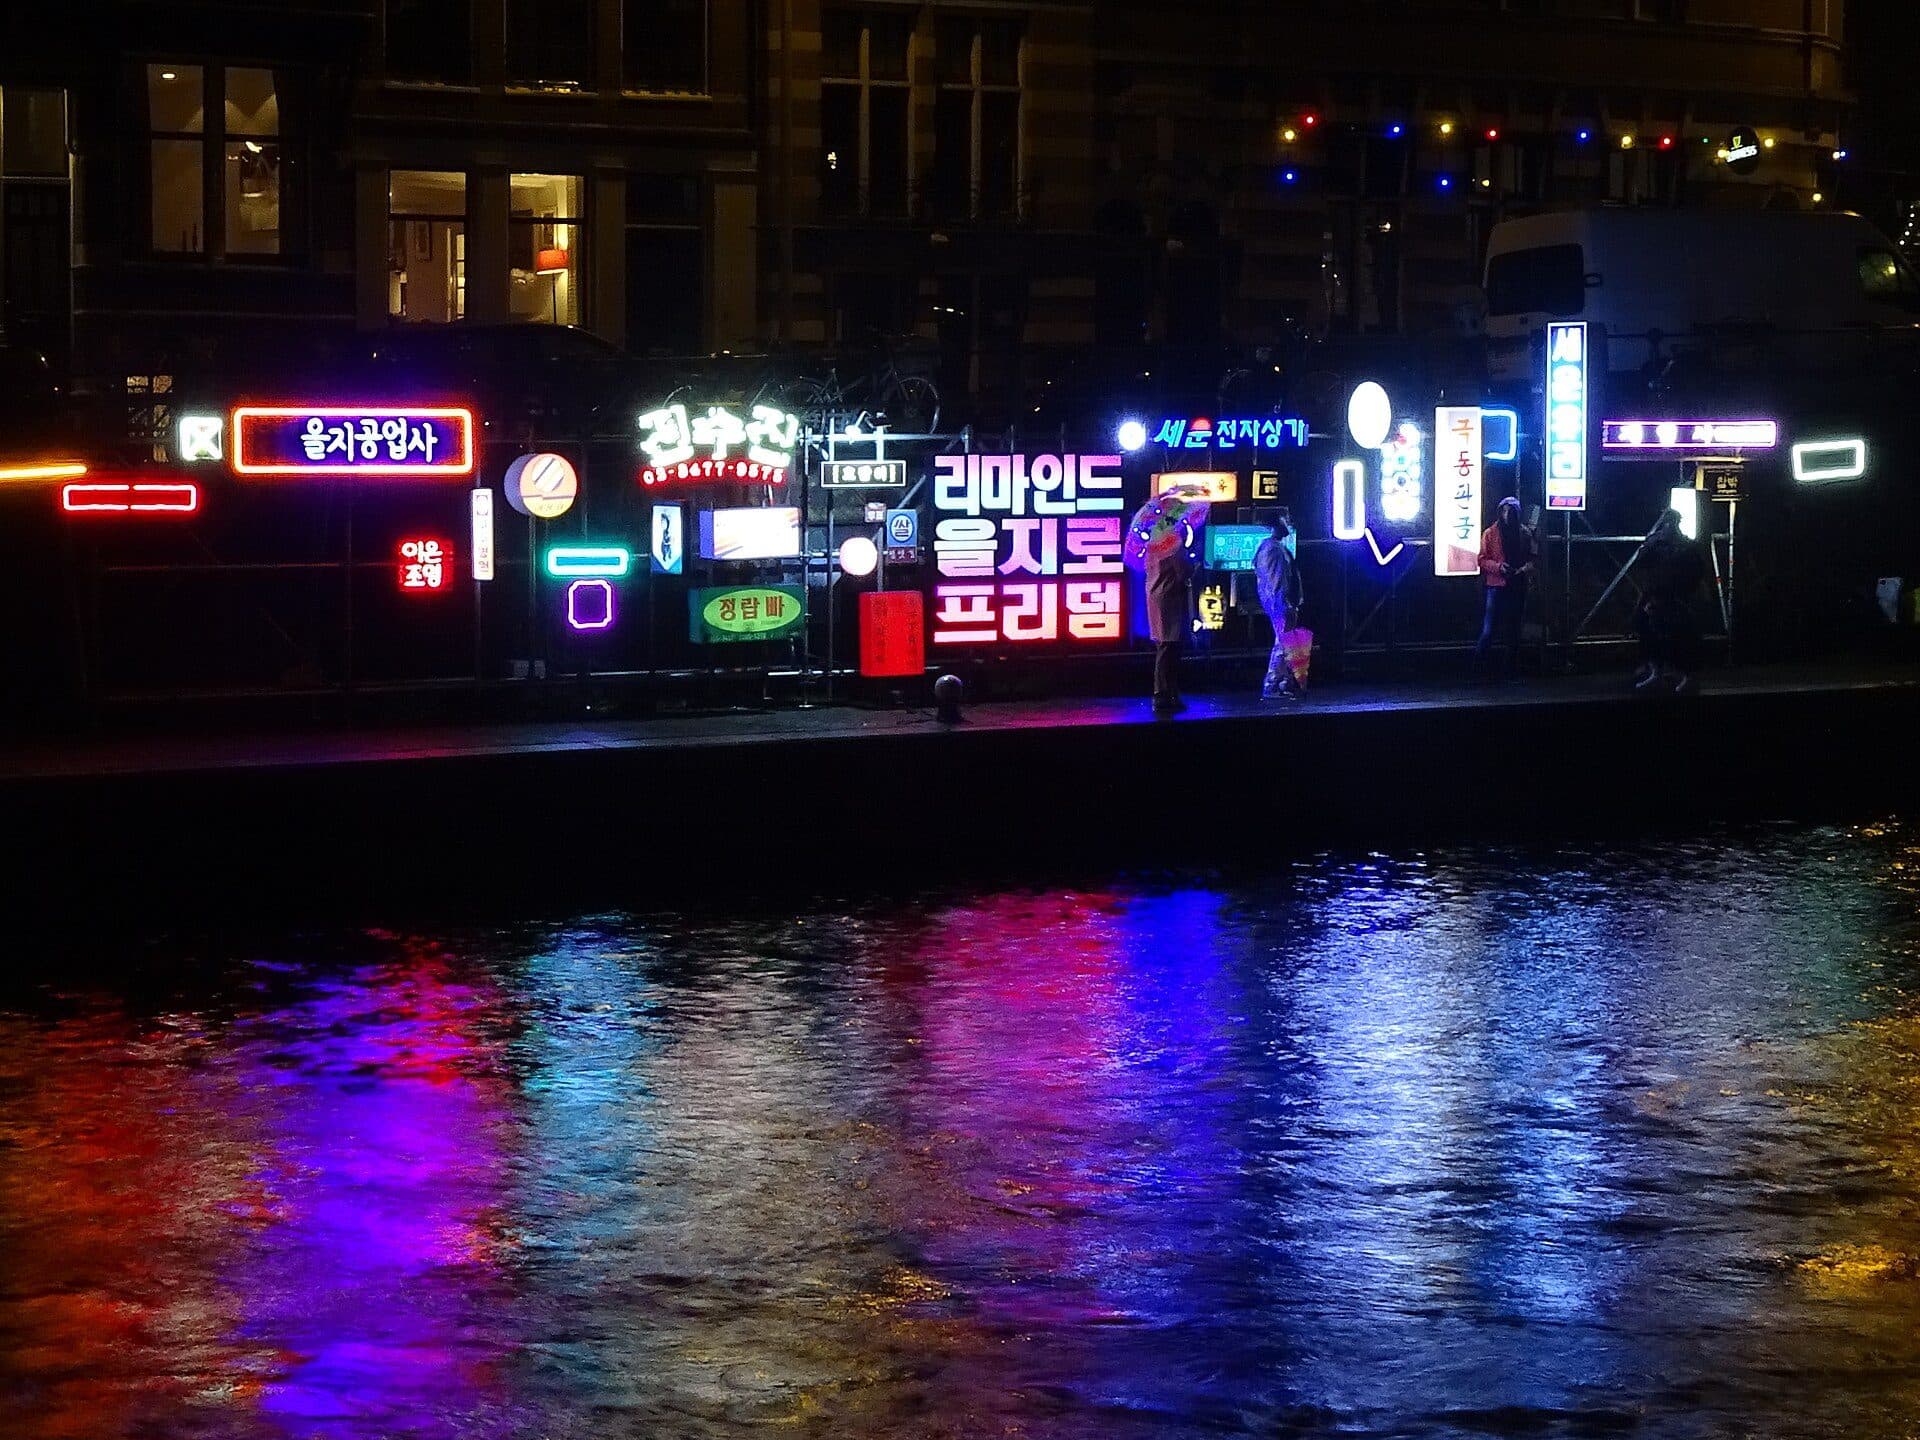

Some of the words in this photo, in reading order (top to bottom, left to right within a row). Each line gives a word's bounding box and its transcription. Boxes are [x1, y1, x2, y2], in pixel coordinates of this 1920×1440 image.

[300, 417, 438, 462] 을지공업사
[934, 454, 1124, 515] 리마인드
[934, 518, 1124, 576] 을지로
[934, 581, 1121, 643] 프리덤
